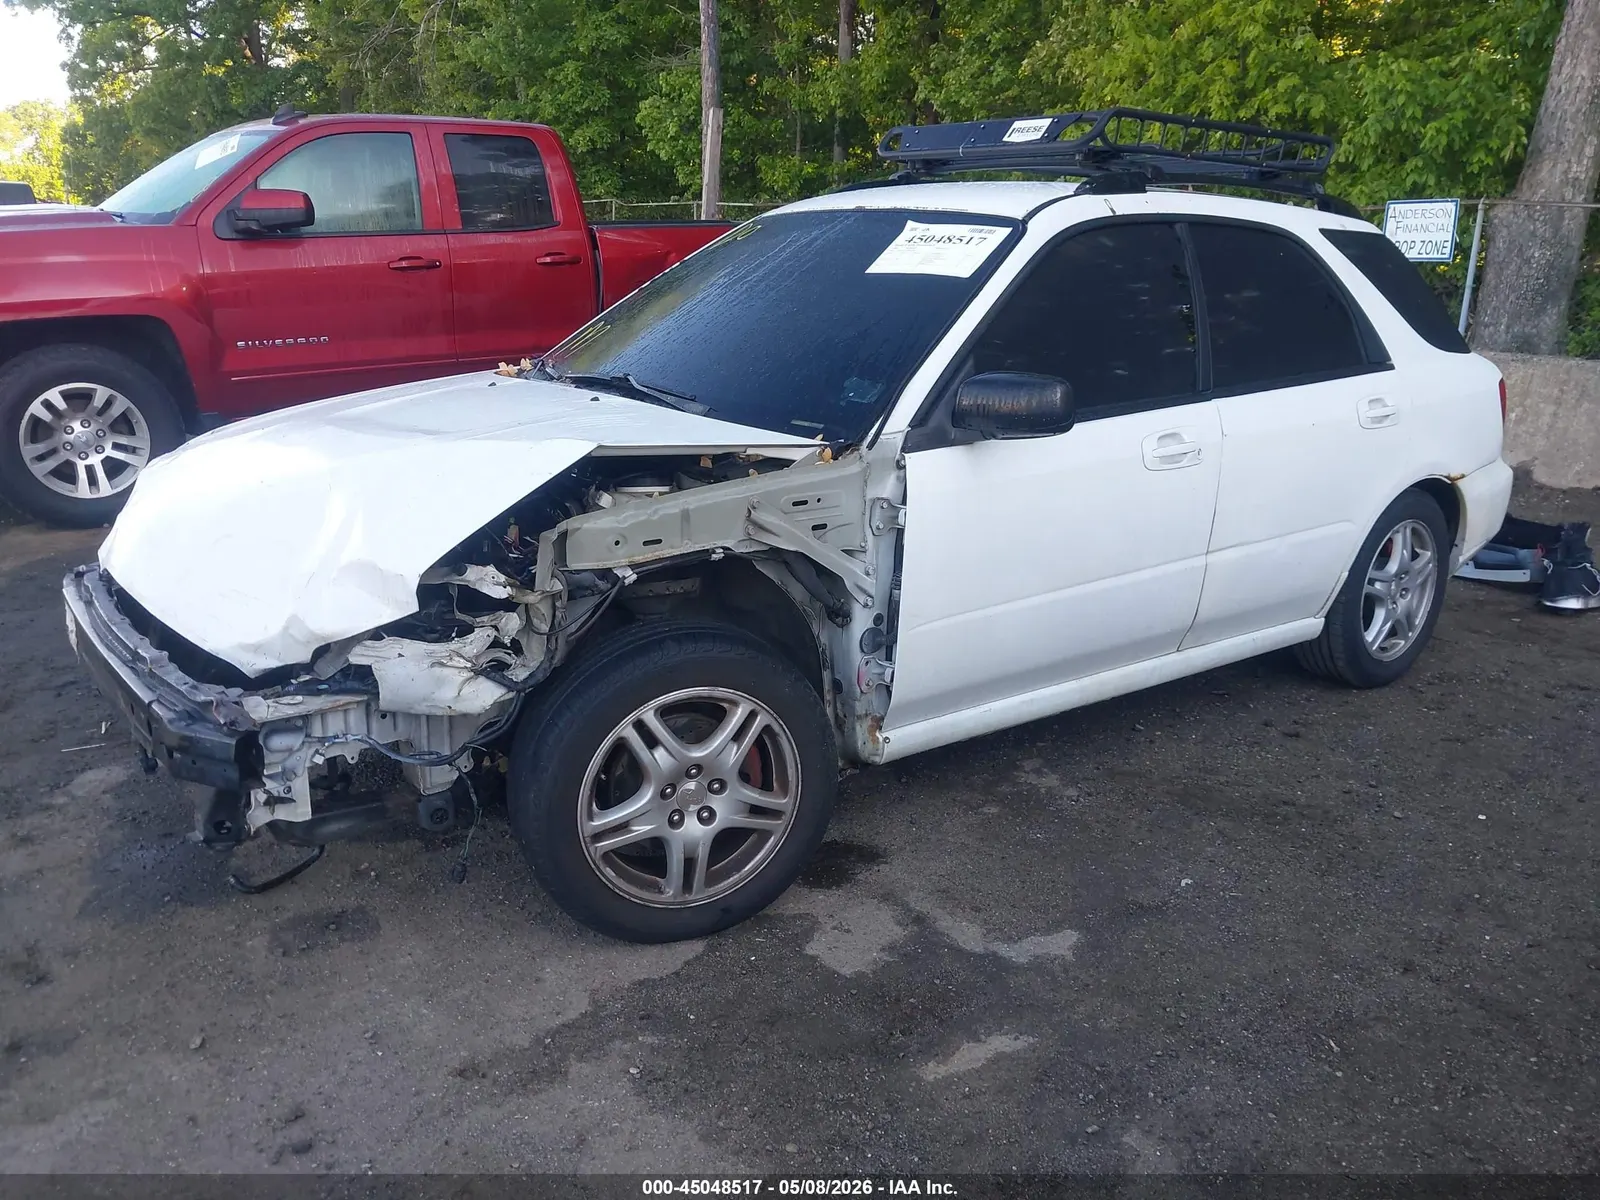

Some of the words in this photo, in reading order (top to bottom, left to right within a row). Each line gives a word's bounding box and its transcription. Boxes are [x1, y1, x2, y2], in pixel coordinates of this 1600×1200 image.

[1012, 125, 1046, 136] REESE
[1389, 206, 1453, 222] ANDERSON
[1395, 220, 1451, 236] FINANCIAL
[905, 234, 988, 246] 45048517
[1417, 240, 1450, 256] ZONE
[236, 336, 329, 348] SILVERADO
